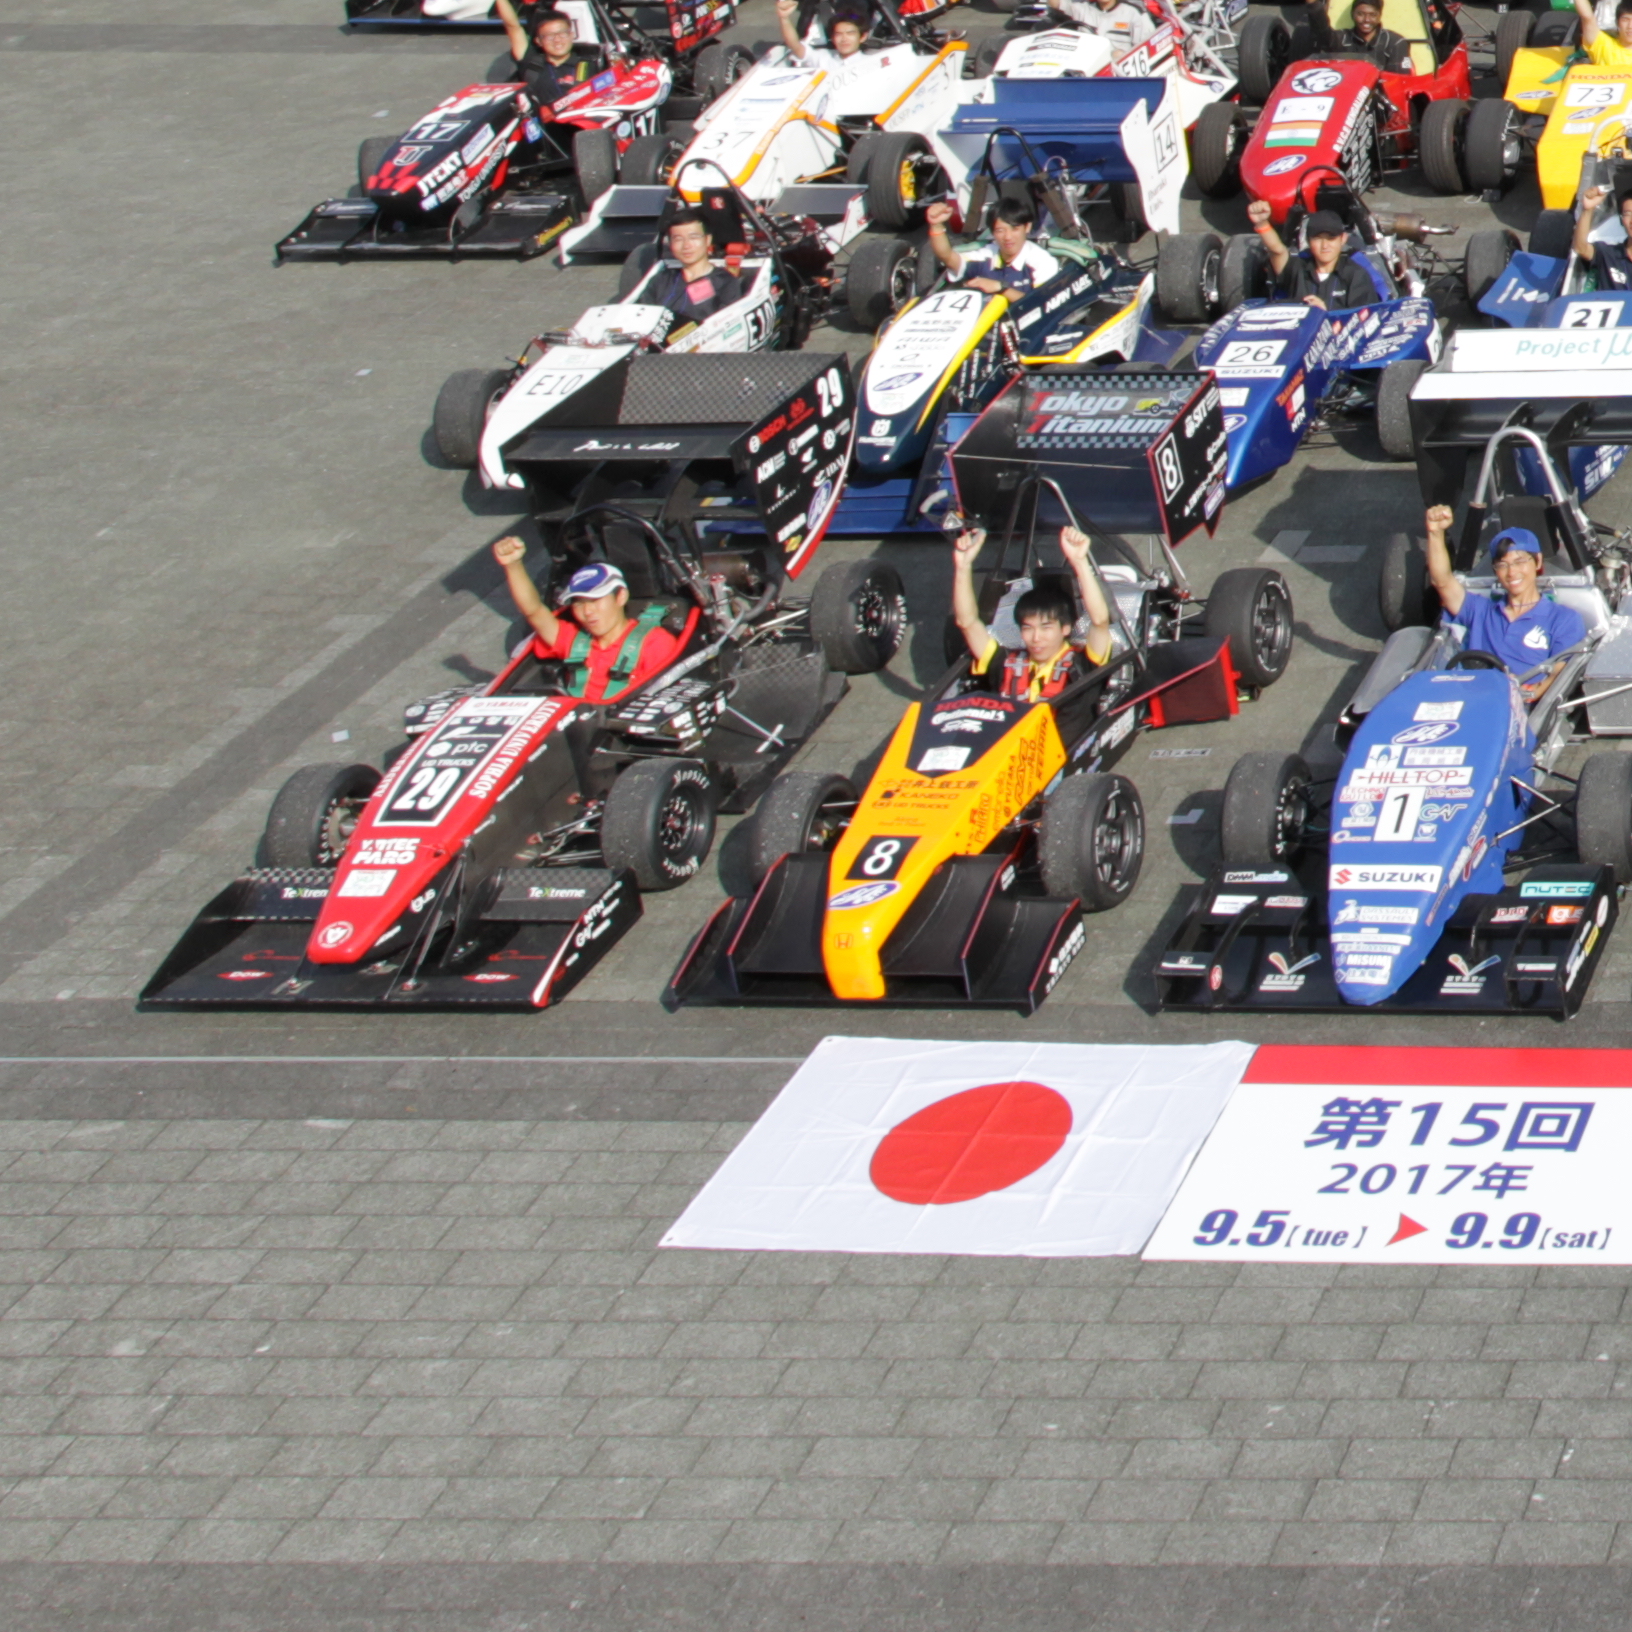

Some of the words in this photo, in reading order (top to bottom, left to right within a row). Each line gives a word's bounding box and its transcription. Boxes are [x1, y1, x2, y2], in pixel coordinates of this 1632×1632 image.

[1574, 85, 1616, 104] 73
[416, 122, 459, 140] 17
[702, 131, 754, 150] 37
[1155, 126, 1175, 162] 14
[419, 152, 463, 197] JTEKT
[925, 293, 973, 315] 14
[1569, 309, 1610, 328] 21
[1231, 344, 1273, 365] 26
[1516, 337, 1601, 359] Project
[525, 374, 584, 396] E10
[815, 368, 844, 418] 29
[1027, 389, 1131, 416] Tokyo
[1027, 411, 1174, 436] Titanium
[1159, 447, 1179, 492] 8
[933, 696, 1016, 713] HONDA
[452, 740, 489, 756] ptc
[469, 757, 515, 799] SOPHIA
[505, 702, 563, 759] UNIVERSITY
[1367, 769, 1459, 785] HILLTOP
[391, 767, 462, 811] 29
[1392, 793, 1412, 835] 1
[351, 850, 417, 865] FARO
[862, 839, 903, 876] 8
[1357, 871, 1436, 884] SUZUKI
[528, 886, 586, 899] TeXtreme
[1524, 882, 1594, 896] NUTEC
[1303, 1096, 1596, 1153] 第15回
[1316, 1162, 1535, 1200] 2017年
